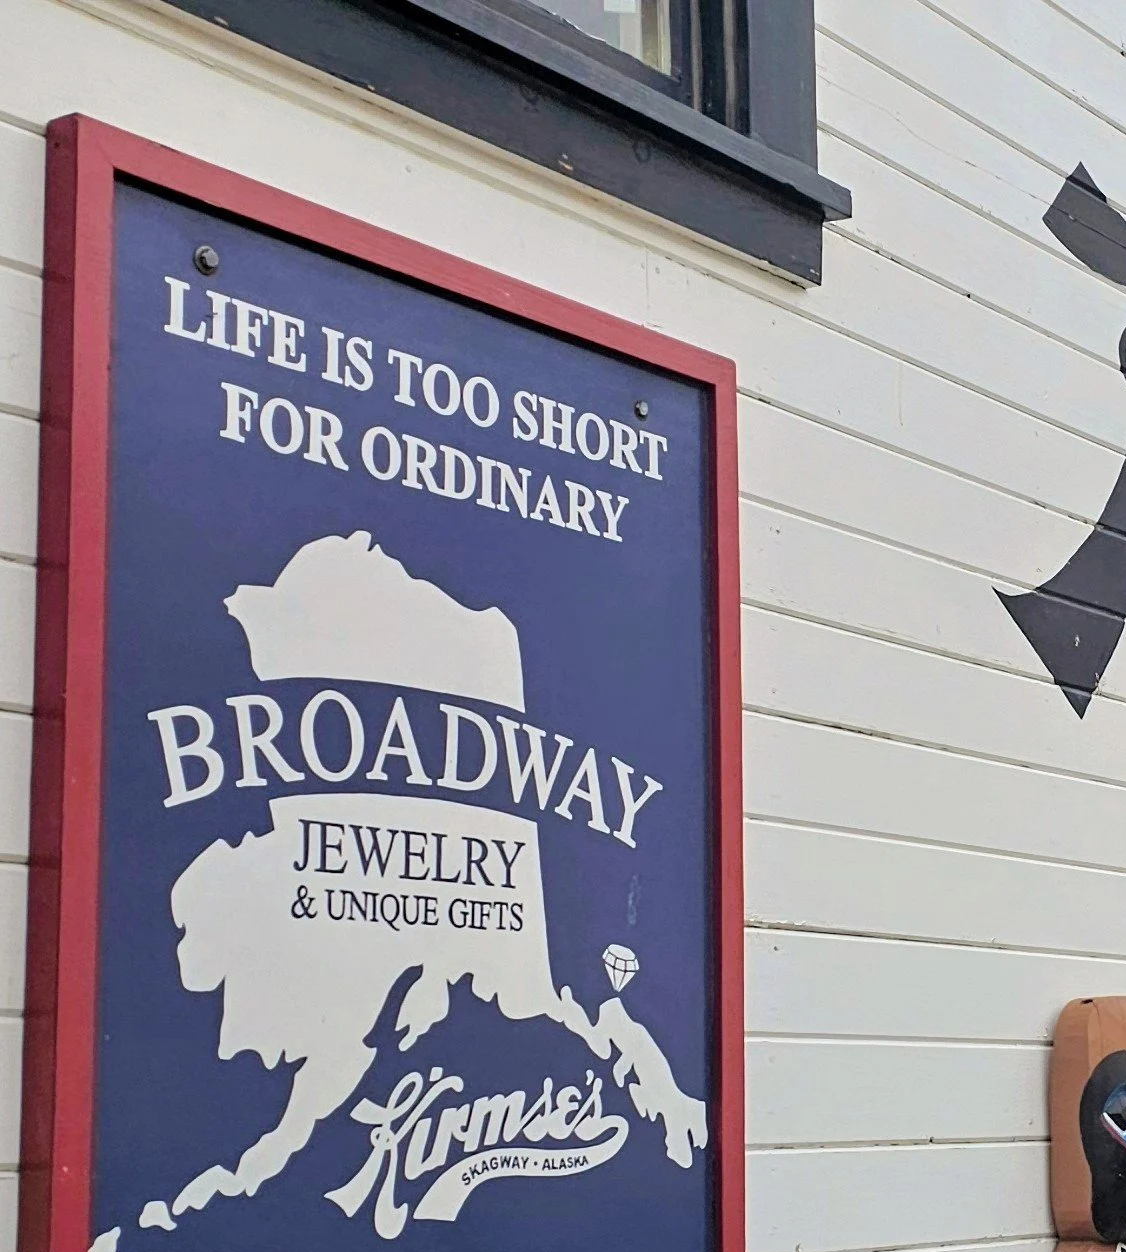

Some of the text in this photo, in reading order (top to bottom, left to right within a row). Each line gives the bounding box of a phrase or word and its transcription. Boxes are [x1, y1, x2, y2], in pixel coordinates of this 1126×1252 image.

[164, 277, 668, 480] LIFE IS TOO SHORT
[219, 382, 630, 542] FOR ORDINARY
[147, 690, 663, 848] BROADWAY
[291, 886, 524, 931] & UNIQUE GIFTS
[293, 820, 527, 889] JEWELRY
[324, 1066, 602, 1239] Kirmse's
[461, 1156, 589, 1186] SKAGWAY ALASKA
